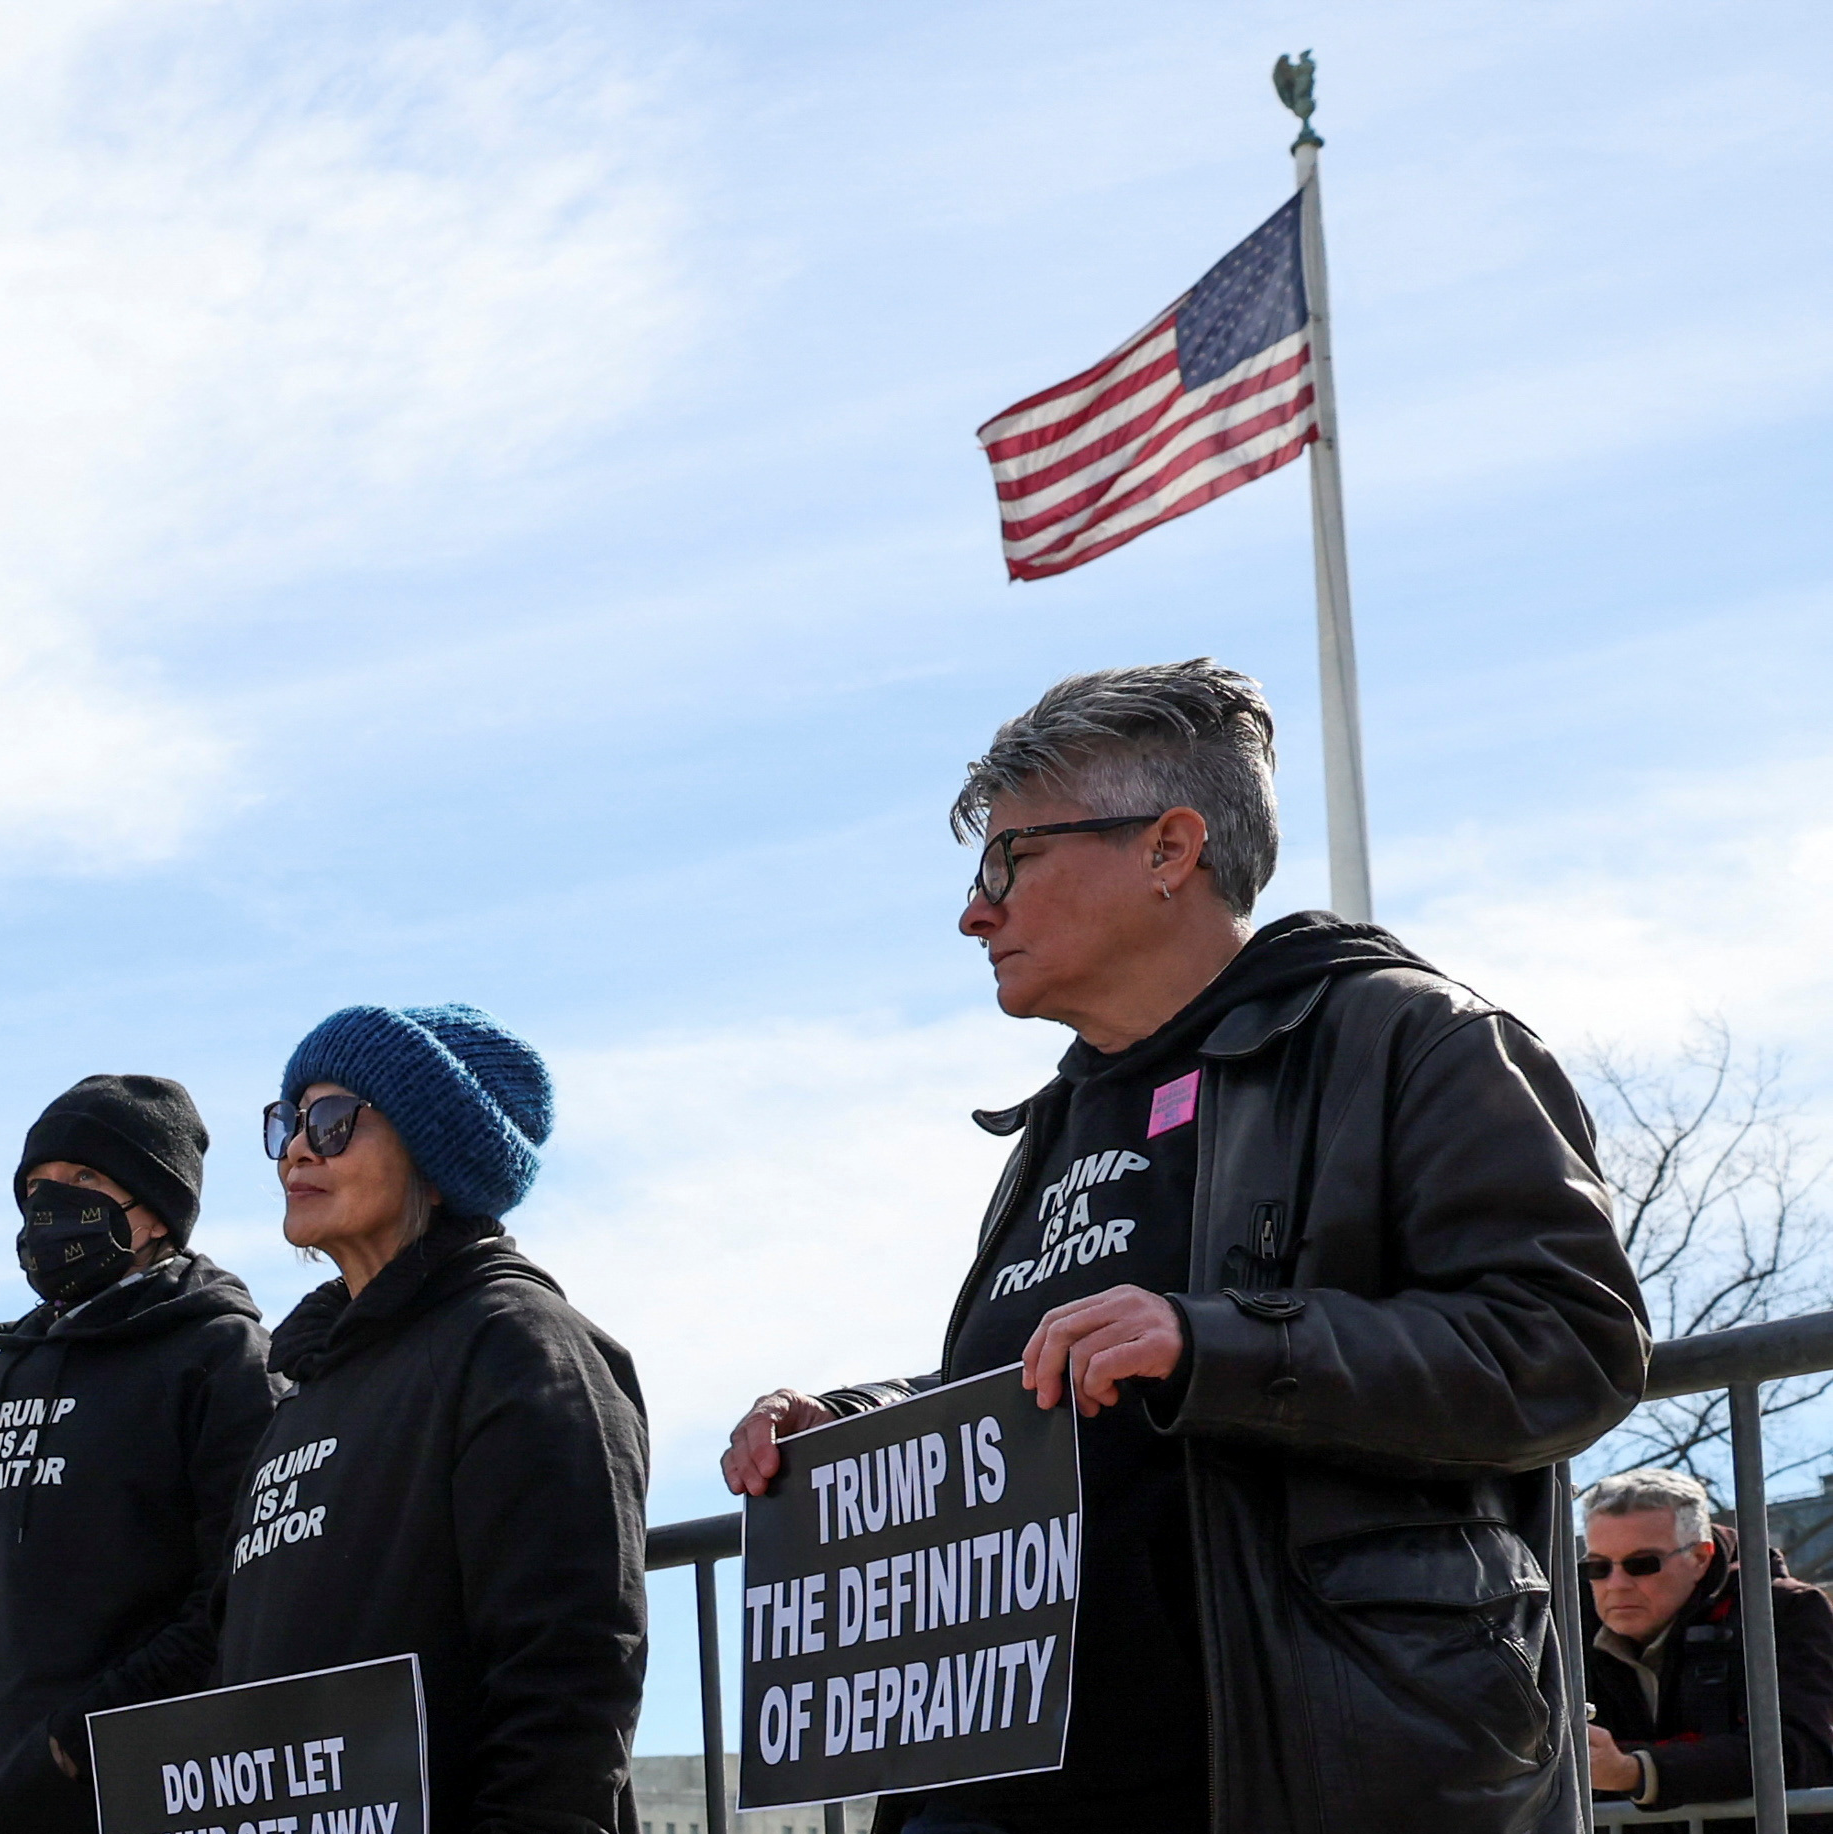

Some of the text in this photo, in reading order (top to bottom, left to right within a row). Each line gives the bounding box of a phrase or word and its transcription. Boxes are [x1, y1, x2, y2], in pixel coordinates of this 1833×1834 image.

[990, 1219, 1135, 1301] TRAITOR
[1041, 1192, 1090, 1252] IS A
[18, 1429, 38, 1456] A
[811, 1415, 1007, 1545] TRUMP IS
[252, 1480, 299, 1525] IS A
[746, 1512, 1078, 1663] THE DEFINITION
[759, 1635, 1058, 1766] OF DEPRAVITY
[162, 1736, 345, 1815] DO NOT LET
